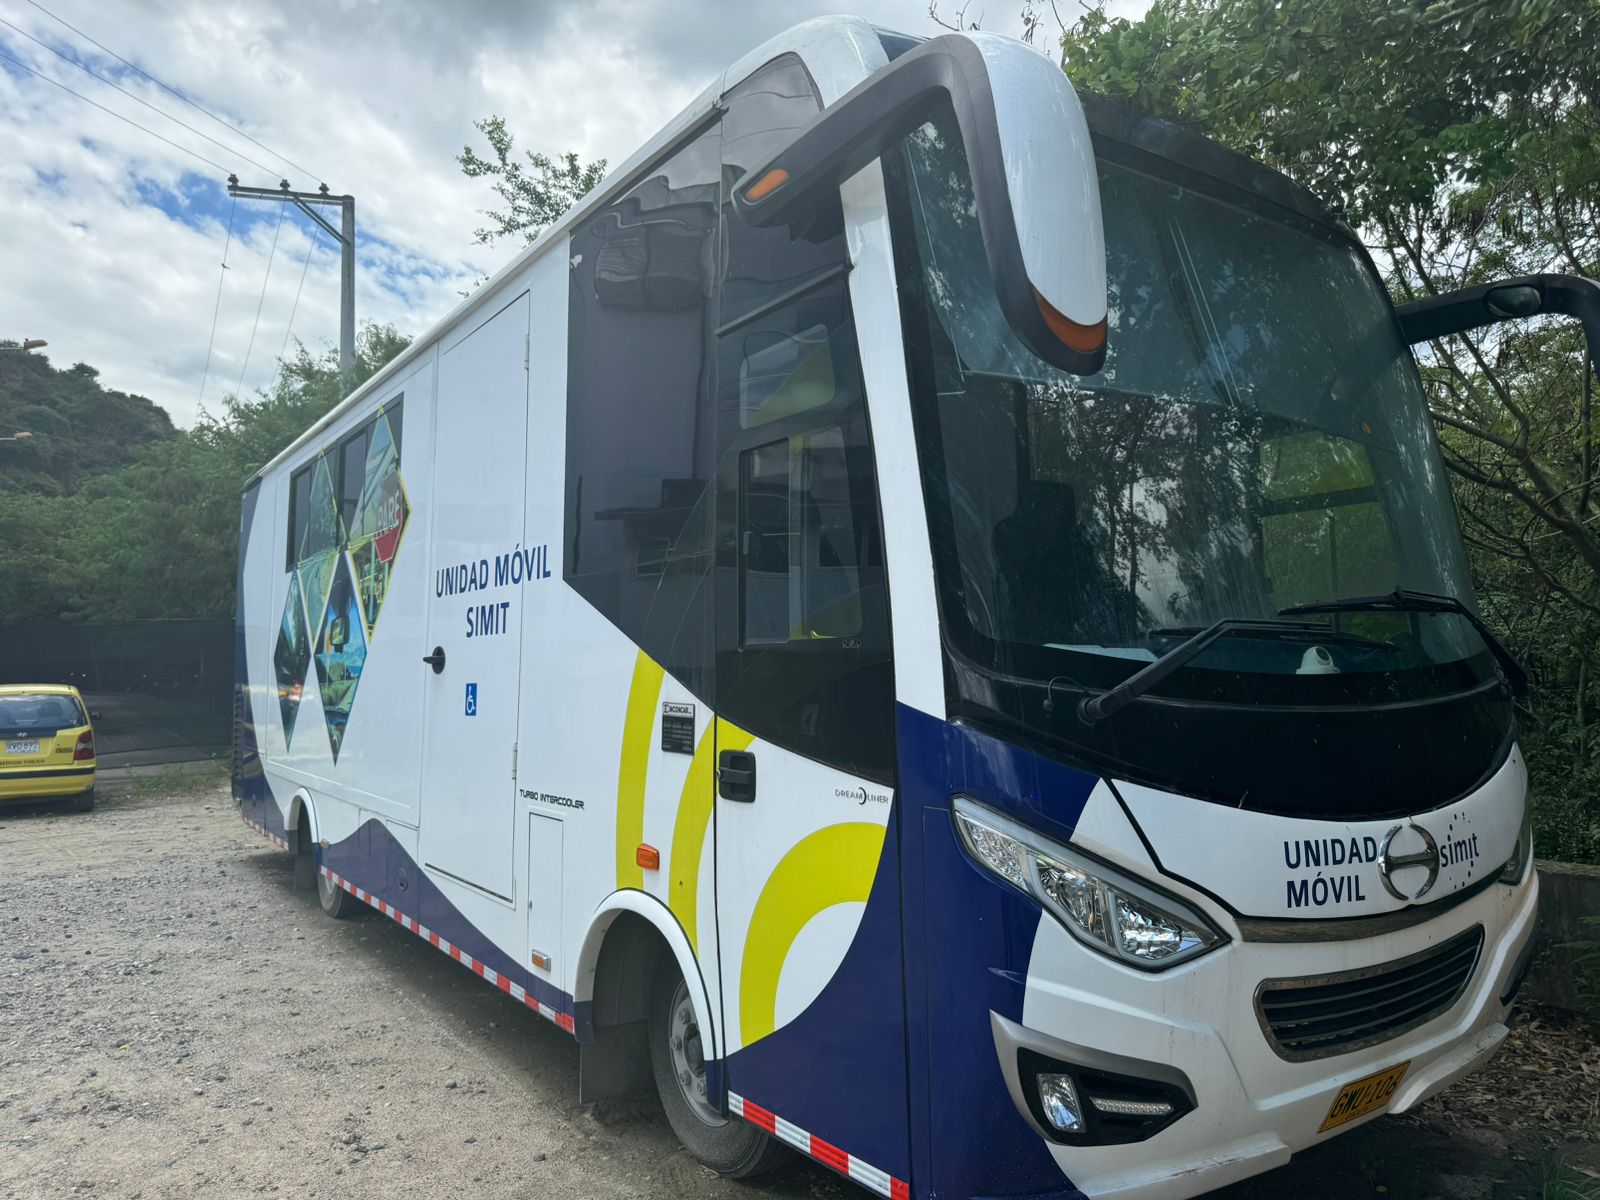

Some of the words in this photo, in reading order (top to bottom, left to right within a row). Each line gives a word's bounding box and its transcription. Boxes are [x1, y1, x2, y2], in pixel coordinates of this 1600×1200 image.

[436, 559, 489, 598] UNIDAD
[495, 543, 551, 588] MÓVIL
[466, 601, 510, 638] SIMIT
[520, 789, 538, 801] TURBO
[540, 793, 584, 810] INTERCOOLER
[1283, 836, 1378, 869] UNIDAD
[1440, 833, 1479, 867] simit
[1286, 871, 1366, 908] MÓVIL
